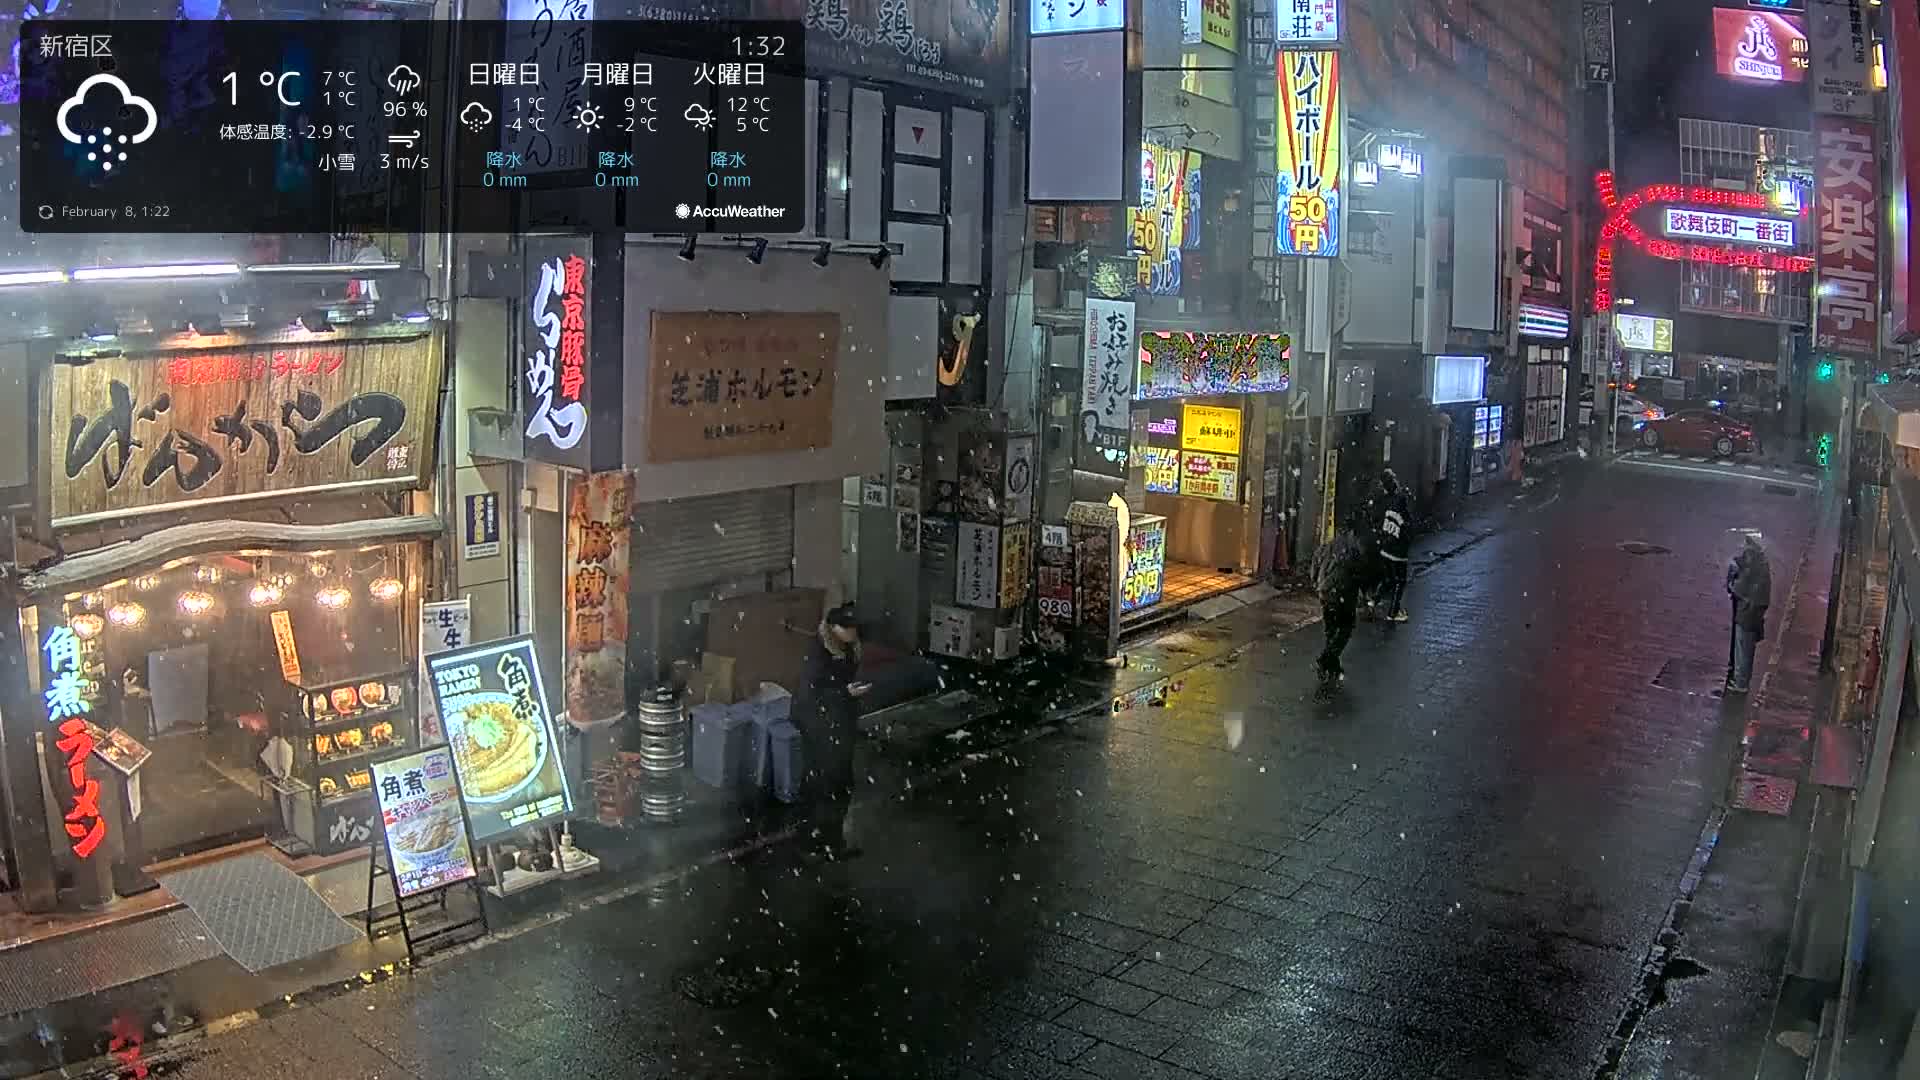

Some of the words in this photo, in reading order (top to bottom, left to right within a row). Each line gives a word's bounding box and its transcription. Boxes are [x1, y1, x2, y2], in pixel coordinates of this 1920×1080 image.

[1295, 55, 1321, 190] ハイボール
[1290, 196, 1325, 222] 50
[1670, 211, 1790, 243] 歌舞伎町一番街
[1133, 218, 1156, 251] 50
[1295, 223, 1319, 252] 円
[1819, 128, 1876, 331] 安楽亭
[560, 255, 585, 400] 東京豚骨
[1100, 310, 1129, 416] お好み焼き
[671, 368, 823, 407] 芝浦ホルモン
[66, 379, 407, 492] ばんから
[435, 664, 480, 684] TOKYO
[499, 655, 540, 720] 角煮
[380, 768, 426, 802] 角煮
